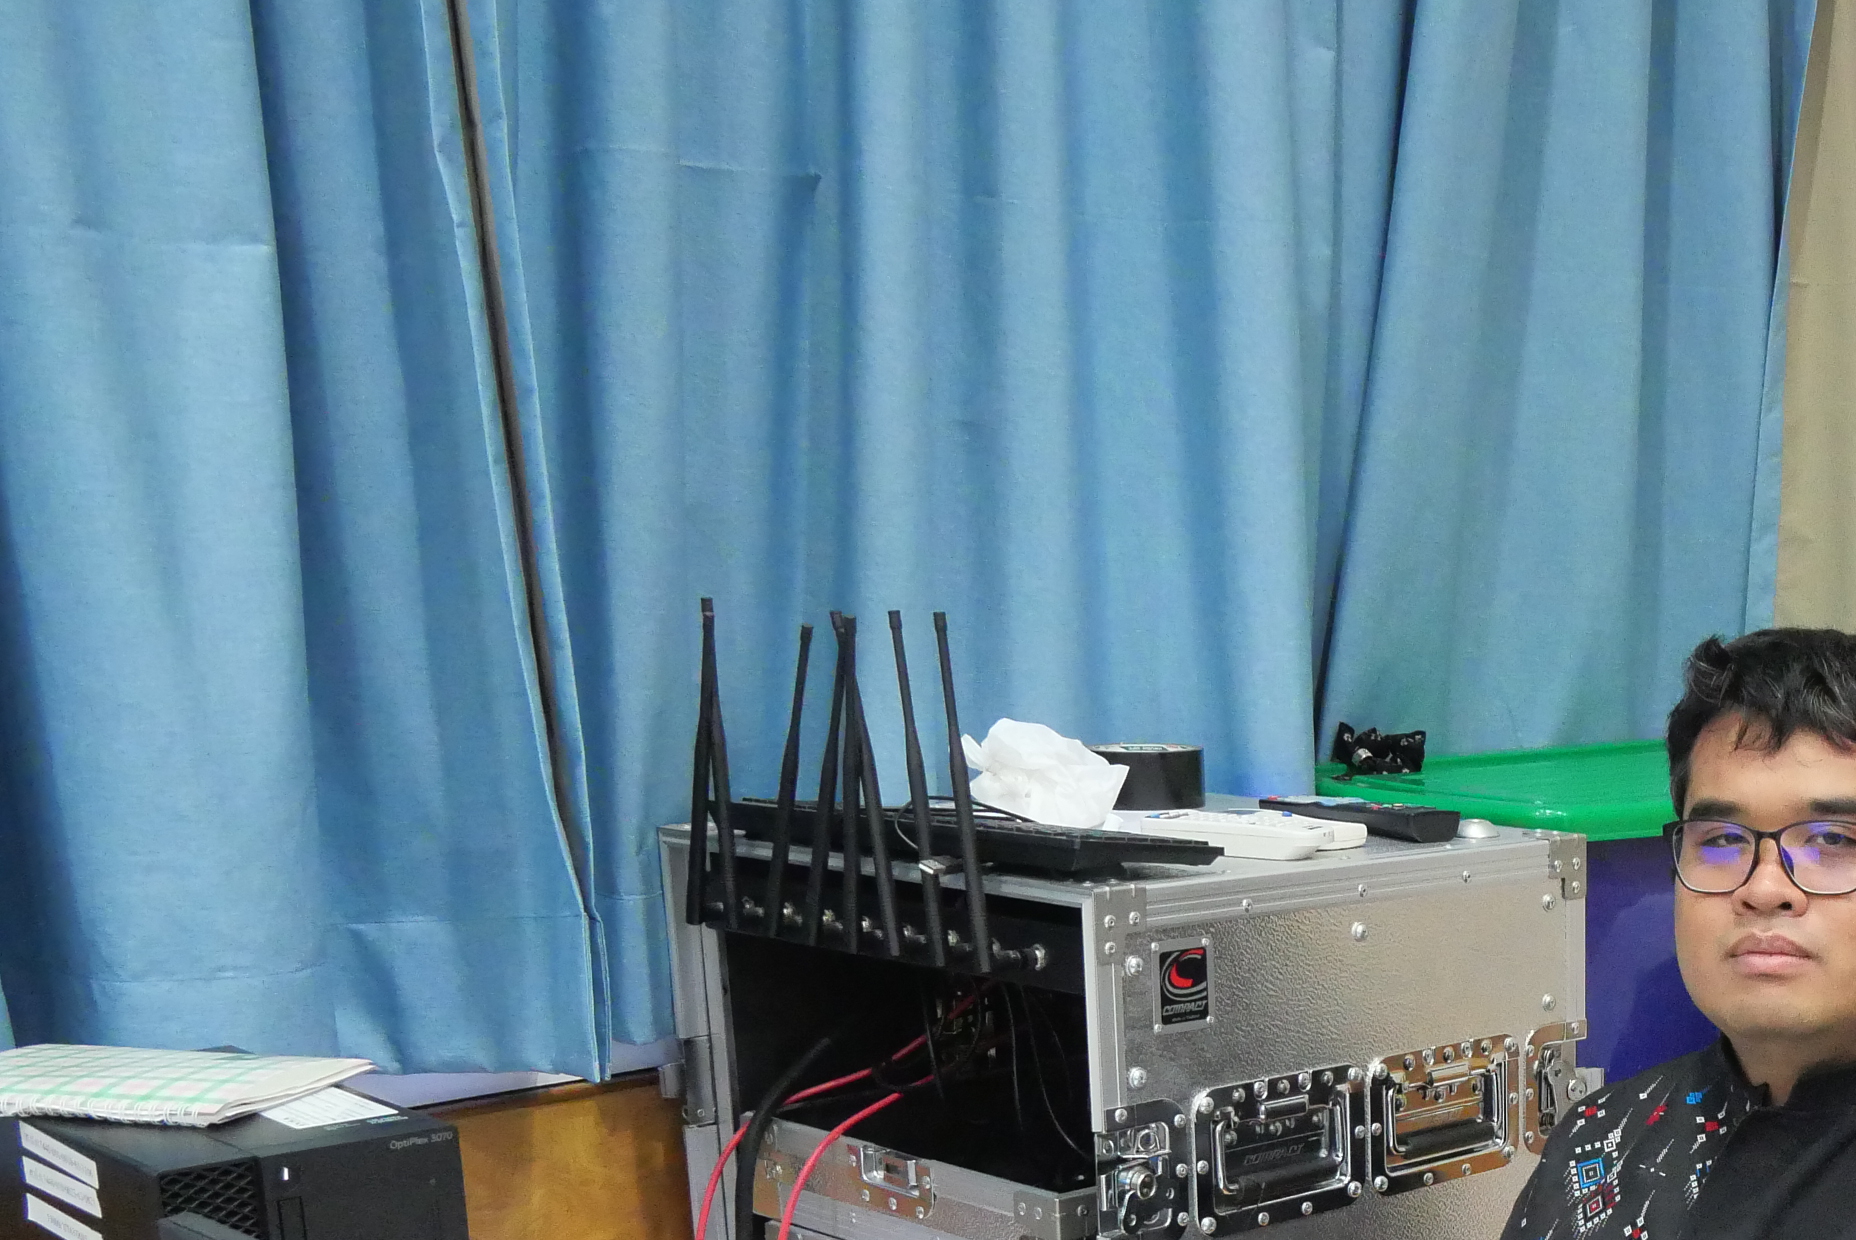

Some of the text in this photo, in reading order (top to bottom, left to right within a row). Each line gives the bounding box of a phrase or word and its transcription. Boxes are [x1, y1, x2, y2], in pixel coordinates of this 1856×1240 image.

[1163, 1000, 1207, 1016] COMPACT
[390, 1131, 453, 1150] OptiPlex 3070
[1244, 1142, 1305, 1166] COMPACT
